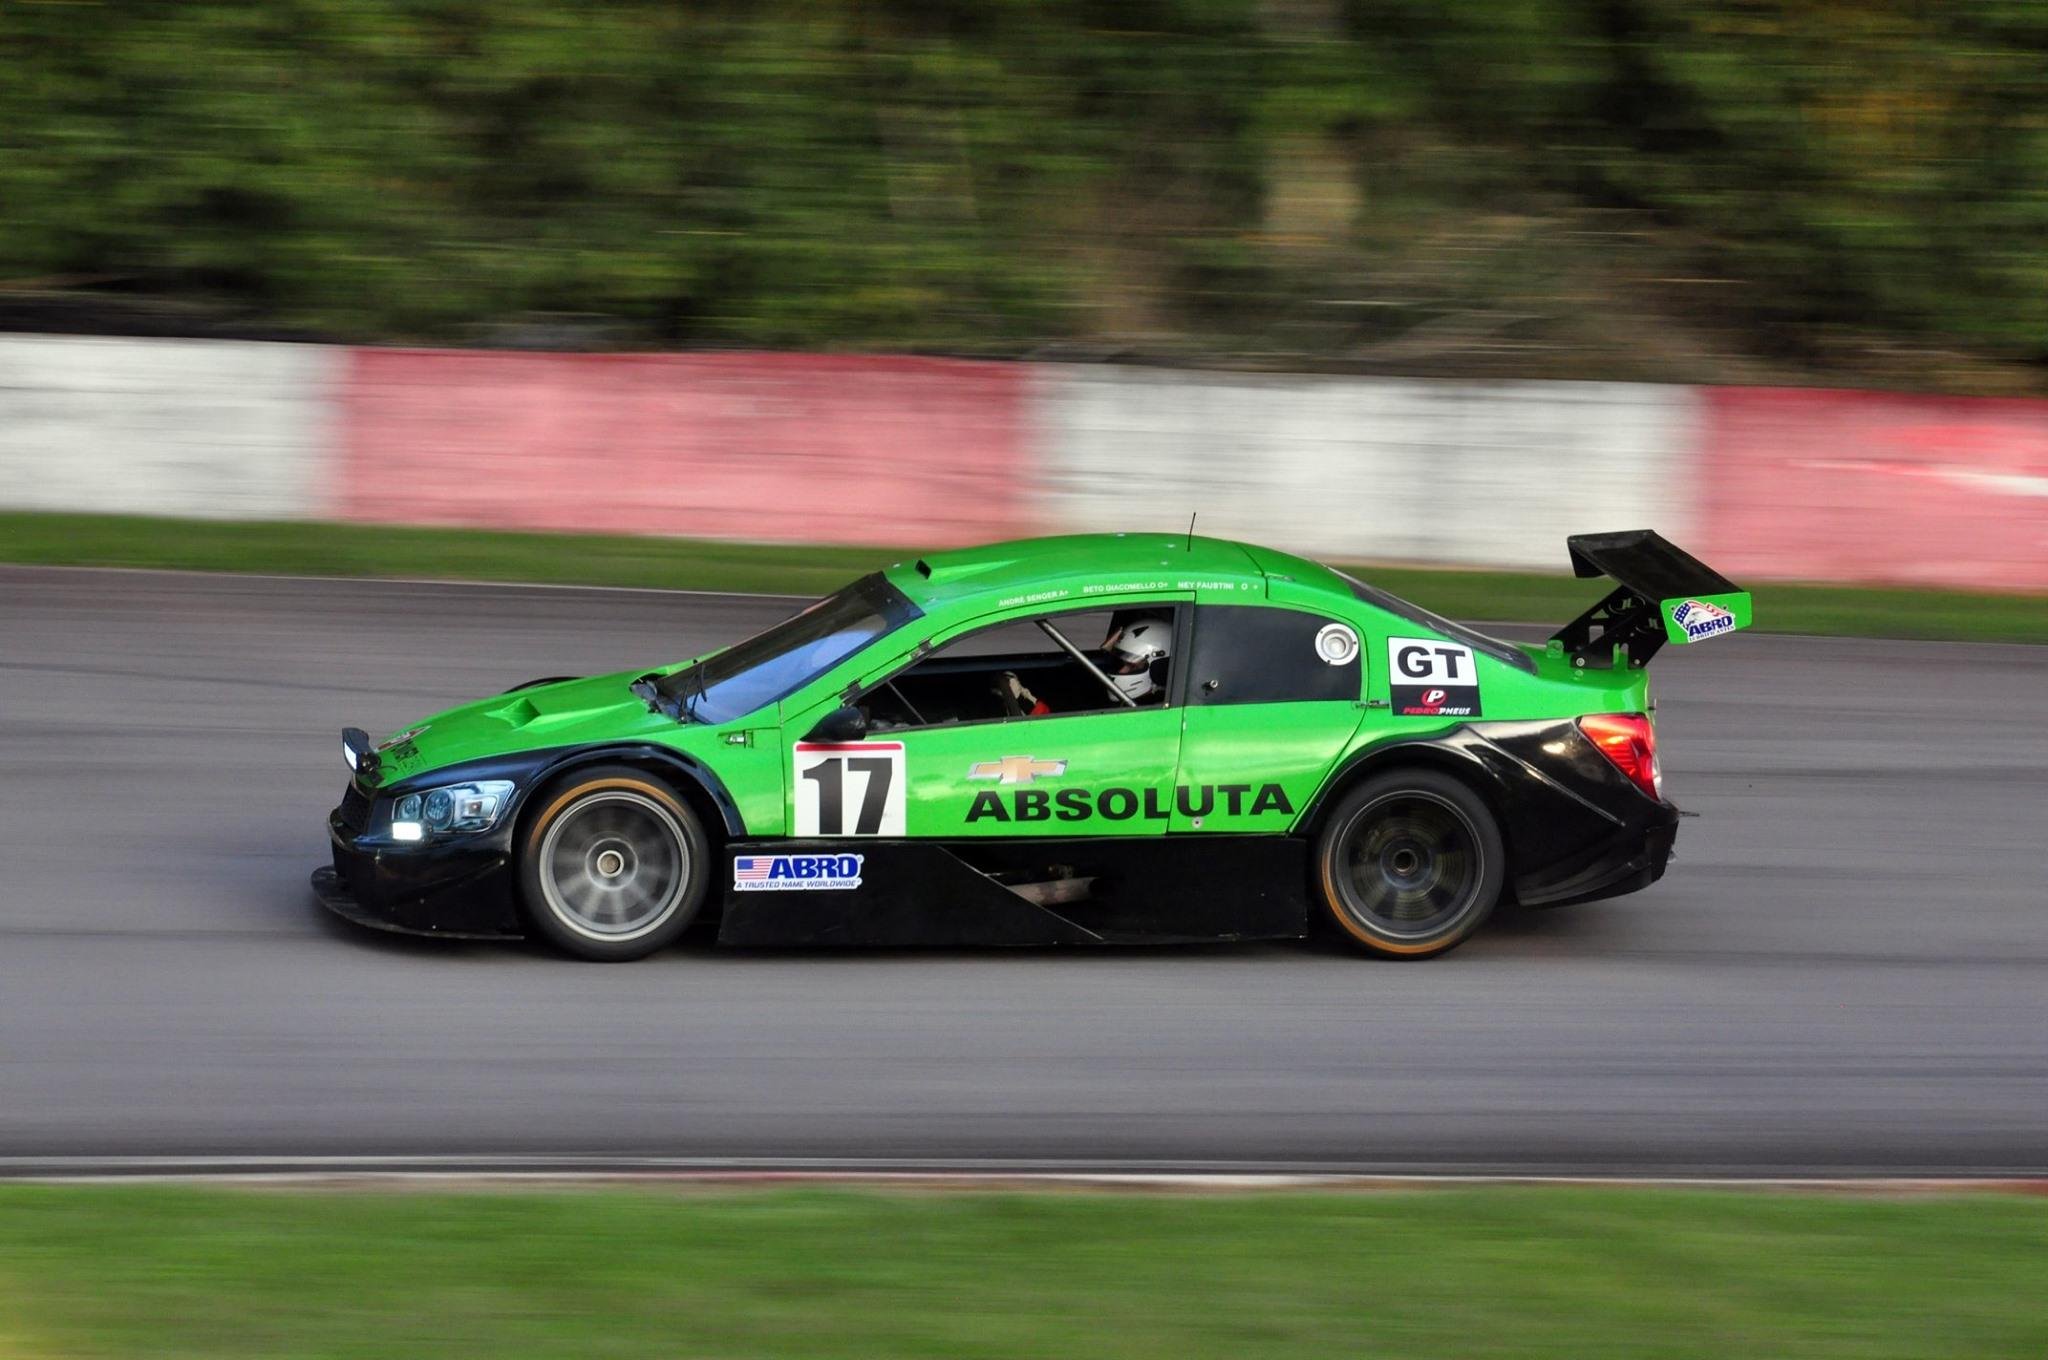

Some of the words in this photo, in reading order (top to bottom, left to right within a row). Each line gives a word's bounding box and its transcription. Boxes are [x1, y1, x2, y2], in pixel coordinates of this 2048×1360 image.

[1177, 582, 1194, 590] NEY
[1689, 616, 1733, 636] ABRO
[1398, 646, 1466, 679] GT
[1426, 690, 1445, 703] P
[802, 757, 893, 835] 17
[964, 783, 1296, 823] ABSOLUTA
[768, 856, 859, 879] ABRO
[736, 881, 743, 889] A
[745, 880, 780, 889] TRUSTED
[782, 880, 804, 888] NAME
[806, 879, 856, 888] WORLDWIDE
